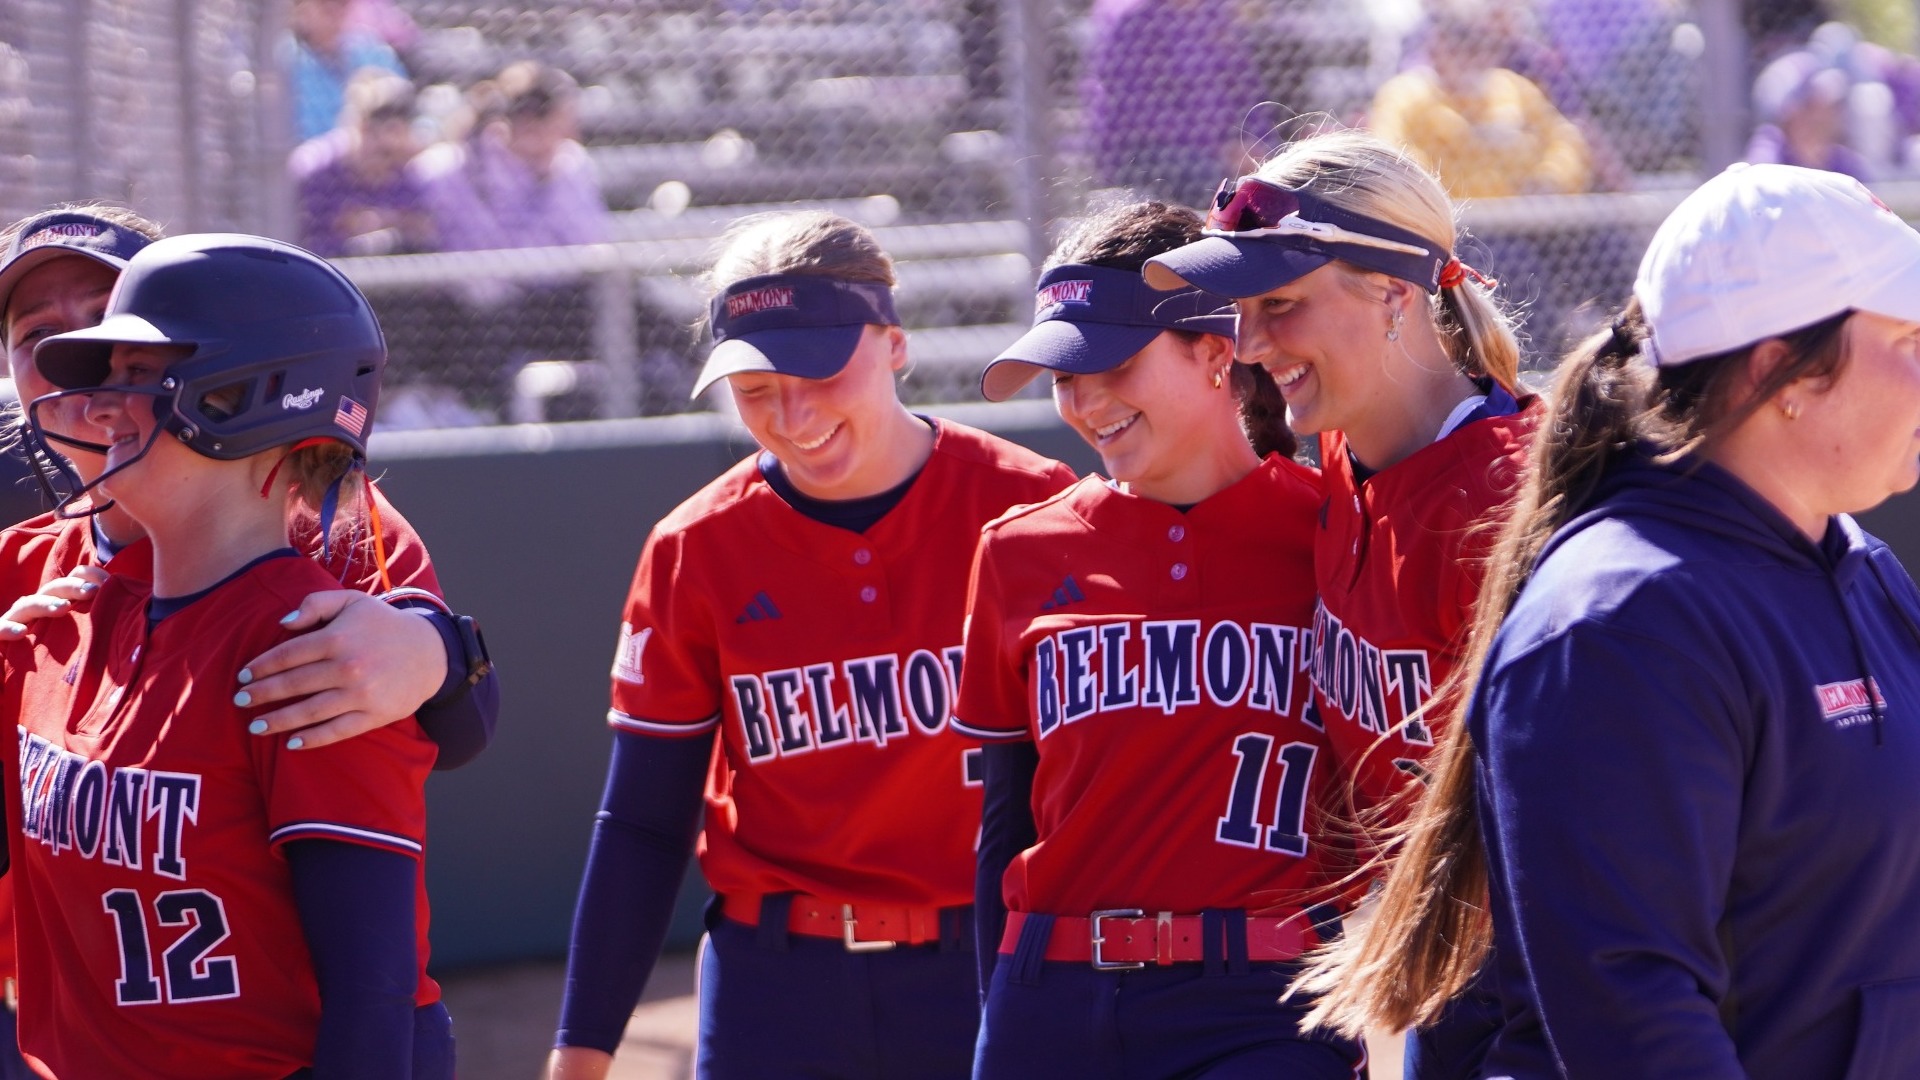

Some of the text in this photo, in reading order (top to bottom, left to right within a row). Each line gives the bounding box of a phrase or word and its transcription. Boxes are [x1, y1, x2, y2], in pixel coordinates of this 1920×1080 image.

[24, 223, 98, 249] MONT
[727, 287, 795, 319] BELMONT
[282, 387, 325, 409] Rawlings
[730, 645, 966, 765] BELMO
[1216, 732, 1319, 857] 11
[102, 888, 240, 1006] 12
